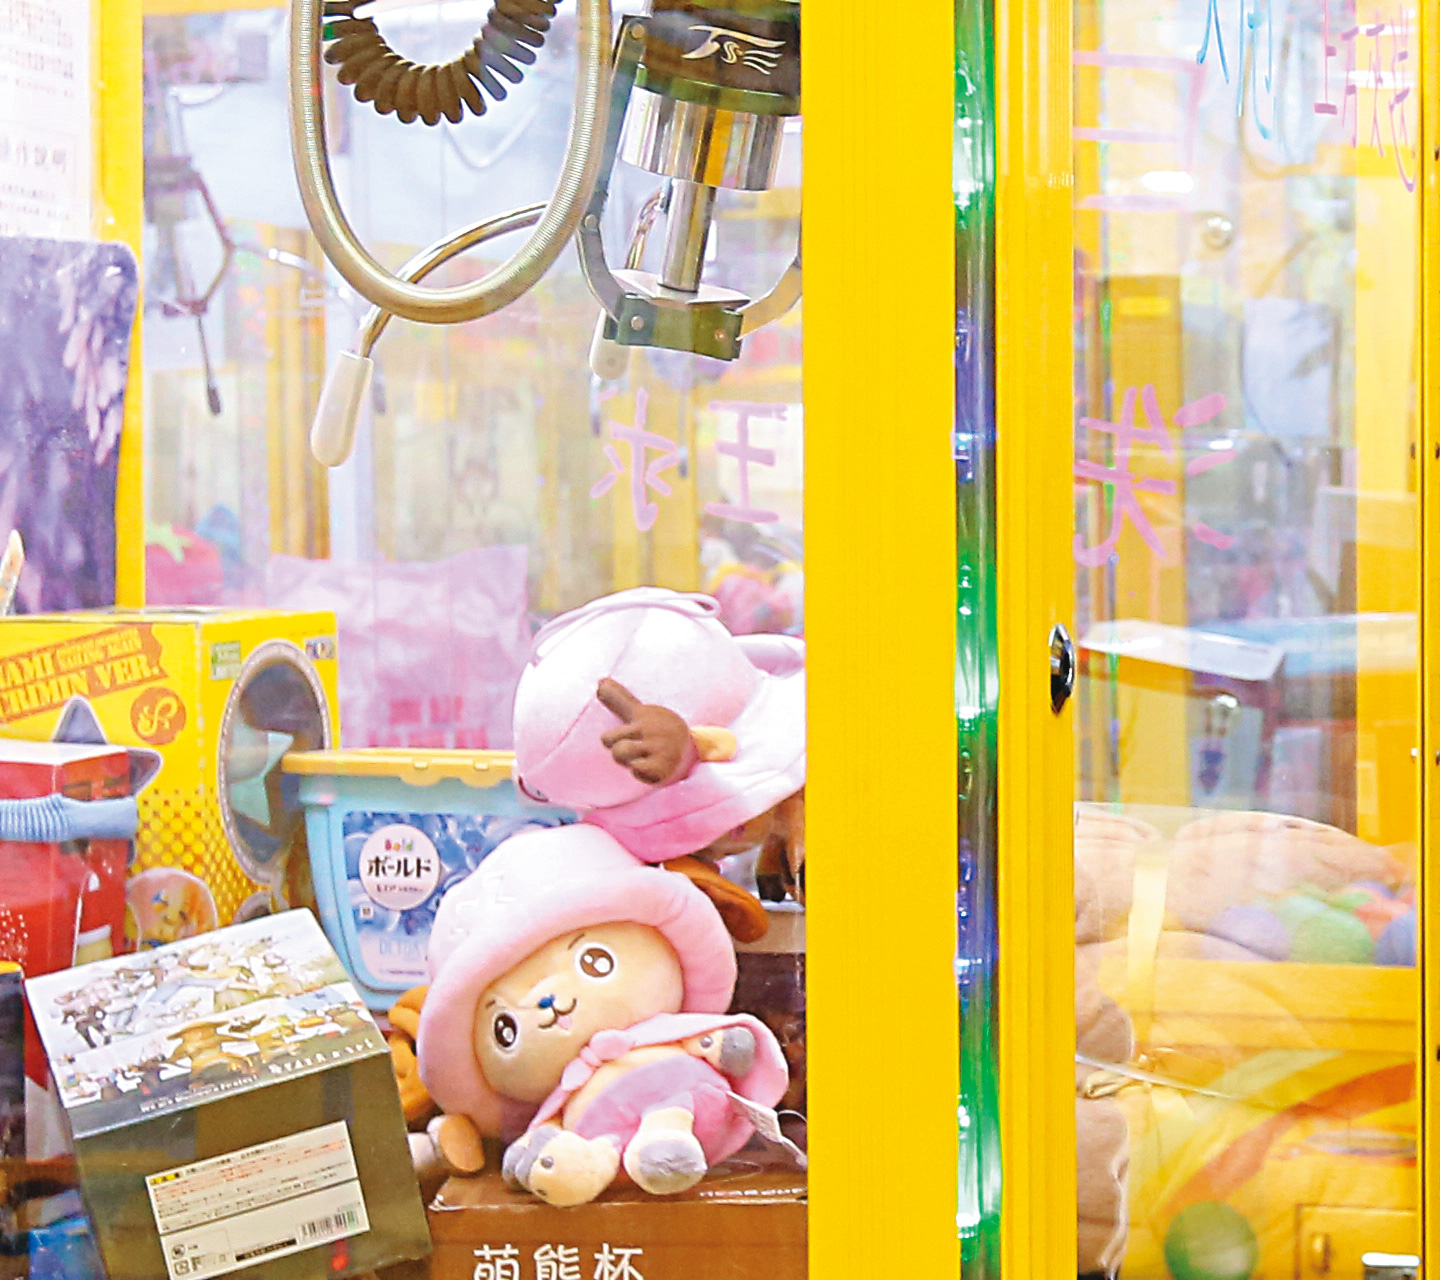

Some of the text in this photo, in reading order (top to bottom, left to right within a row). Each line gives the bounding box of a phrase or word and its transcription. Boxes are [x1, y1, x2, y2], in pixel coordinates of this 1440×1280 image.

[93, 654, 160, 690] VER.
[367, 855, 433, 879] ボールド
